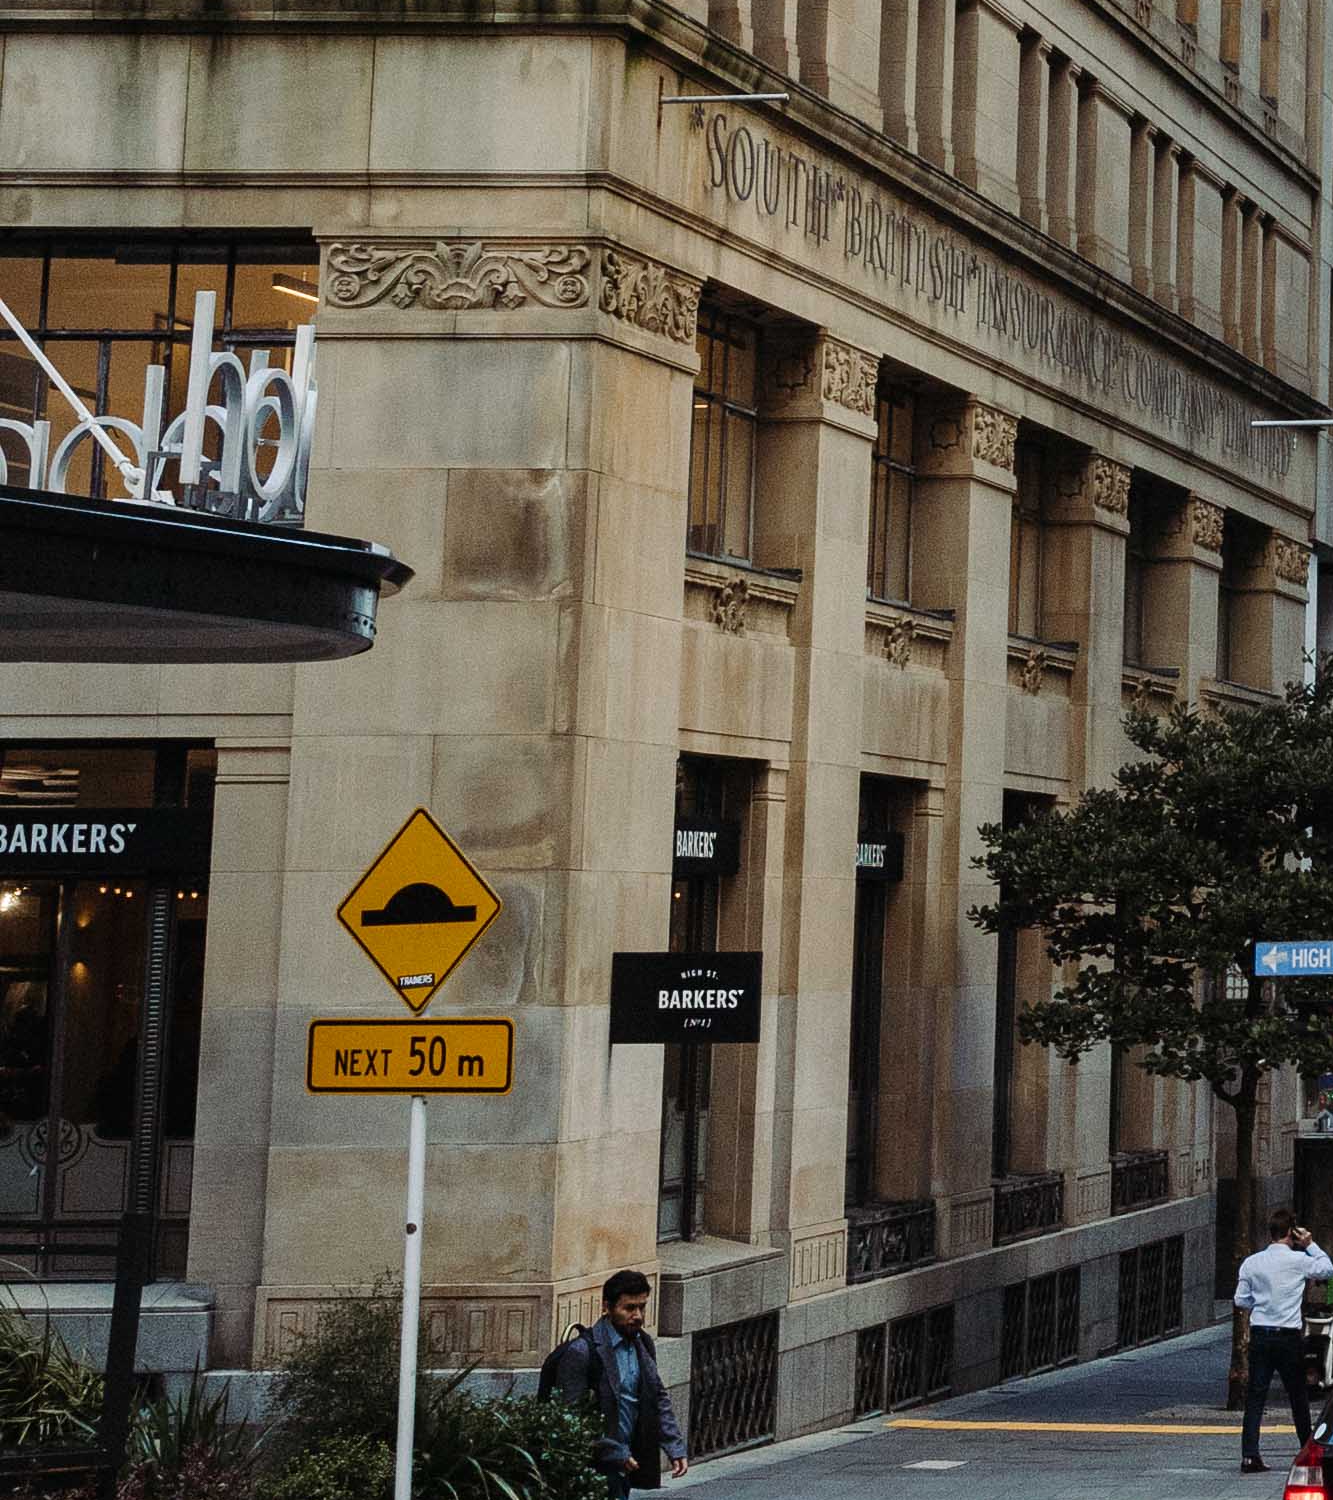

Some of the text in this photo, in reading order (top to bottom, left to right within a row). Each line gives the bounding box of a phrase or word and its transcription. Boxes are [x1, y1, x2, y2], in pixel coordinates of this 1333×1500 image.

[706, 112, 831, 248] SOUTH
[845, 176, 967, 320] BRITISH
[975, 261, 1118, 396] INSURANCE
[676, 829, 714, 858] BARKERS
[1291, 948, 1332, 969] HIGH
[658, 989, 738, 1009] BARKERS
[335, 1035, 484, 1077] NEXT 50 m
